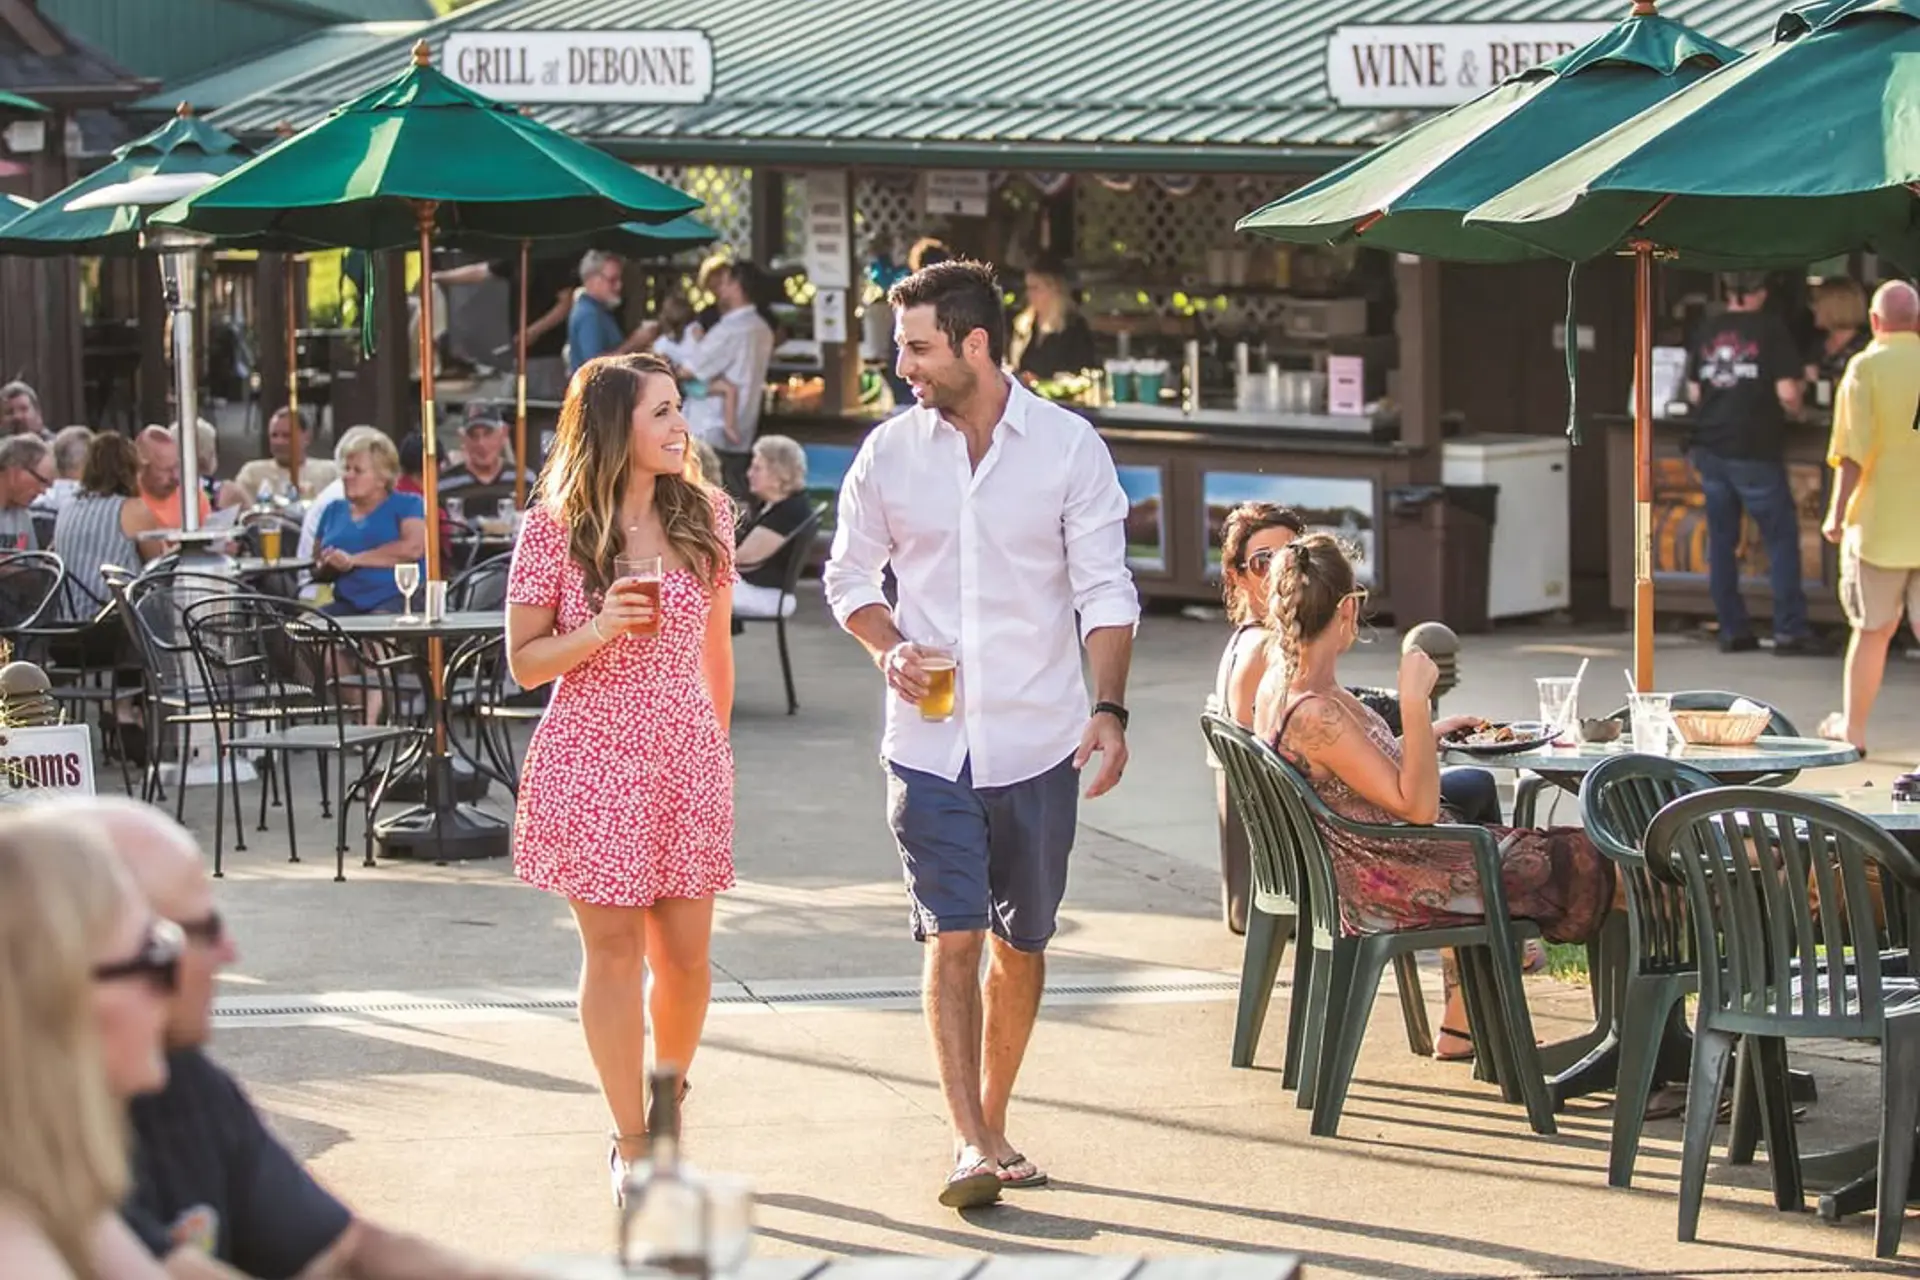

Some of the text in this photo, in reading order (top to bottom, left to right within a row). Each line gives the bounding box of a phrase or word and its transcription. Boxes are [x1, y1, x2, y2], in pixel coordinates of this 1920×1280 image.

[457, 46, 695, 85] GRILL at DEBONNE
[1351, 43, 1576, 87] WINE & BEE
